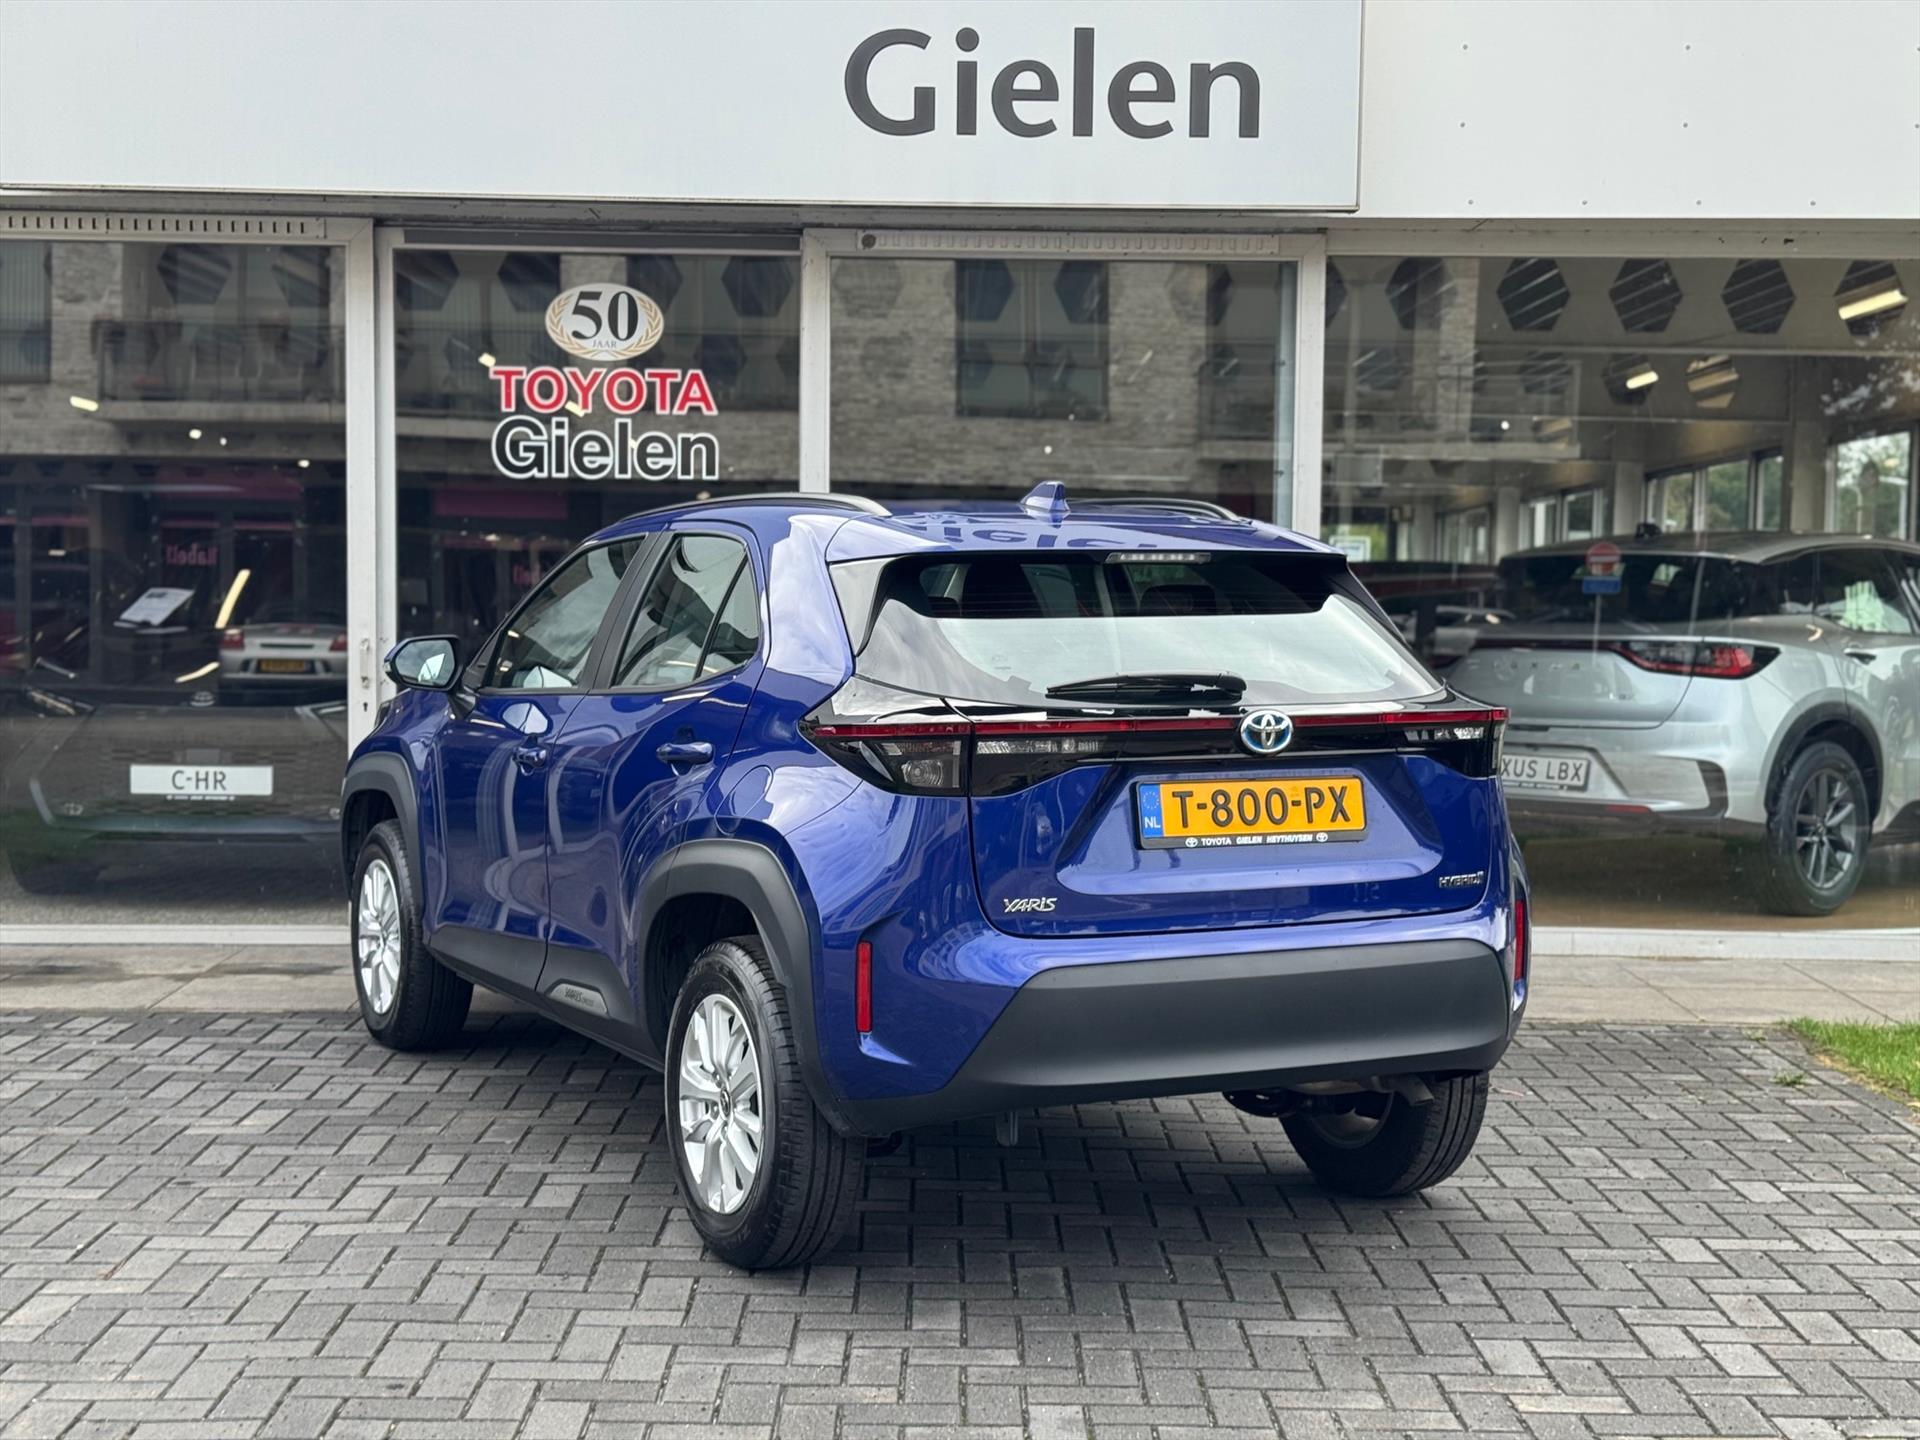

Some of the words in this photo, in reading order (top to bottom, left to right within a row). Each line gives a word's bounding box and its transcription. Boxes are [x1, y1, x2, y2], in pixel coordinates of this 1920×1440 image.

[844, 26, 1260, 140] Gielen
[571, 290, 639, 341] 50
[592, 340, 617, 349] JAAR
[489, 366, 719, 416] TOYOTA
[491, 415, 720, 480] Gielen
[171, 769, 227, 791] C-HR
[1501, 757, 1538, 779] XUS
[1545, 760, 1584, 782] LBX
[1172, 785, 1351, 828] T-800-PX
[1144, 816, 1161, 829] NL
[1201, 838, 1232, 846] TOYOTA
[1236, 836, 1263, 845] GIELEN
[1266, 834, 1313, 844] HEYTHUYSEN
[1003, 896, 1058, 913] YARIS
